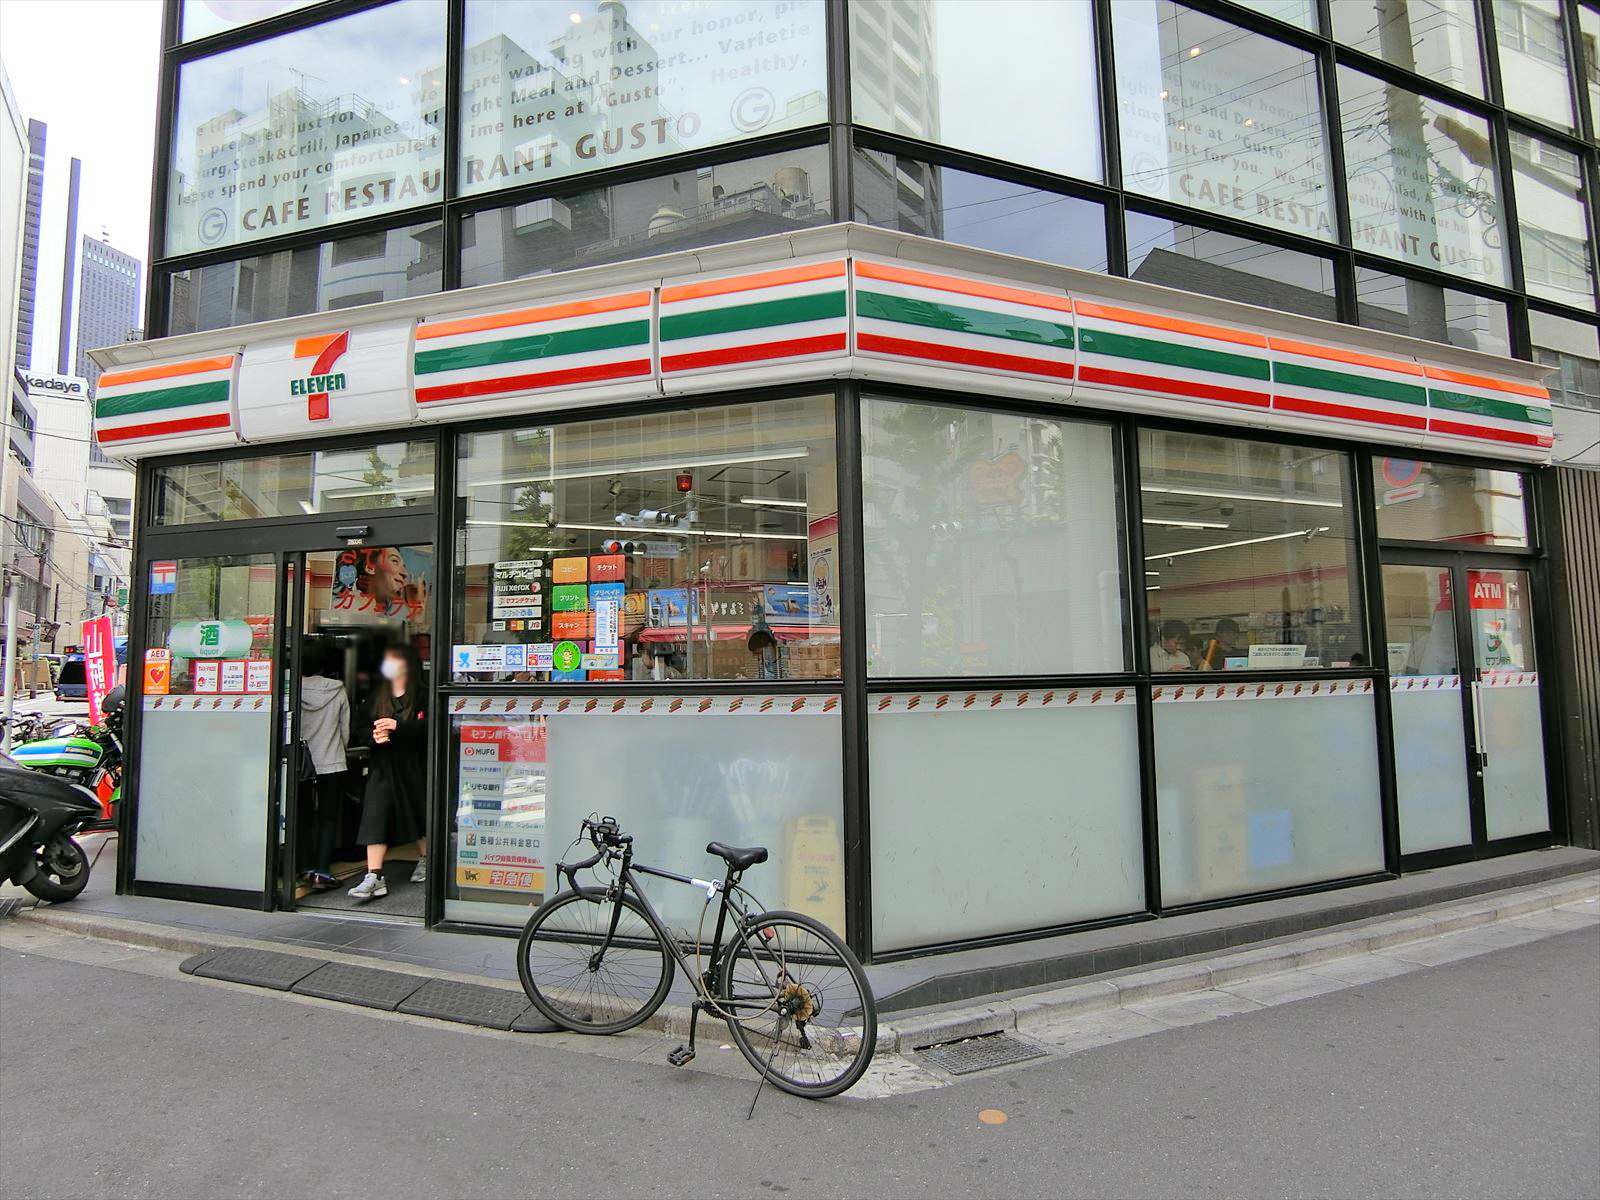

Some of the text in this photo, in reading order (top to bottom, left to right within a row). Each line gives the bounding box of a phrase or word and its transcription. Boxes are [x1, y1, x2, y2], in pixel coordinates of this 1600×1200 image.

[511, 80, 556, 105] Meal
[564, 70, 600, 93] and
[512, 108, 556, 129] here
[564, 99, 585, 117] at
[466, 111, 702, 185] RANT GUSTO
[220, 173, 267, 198] spend
[272, 166, 310, 189] your
[1178, 173, 1247, 211] CAFÉ
[242, 167, 442, 231] CAFÉ RESTAU
[1399, 206, 1427, 224] with
[293, 330, 349, 421] 7
[1473, 582, 1502, 599] ATM
[199, 624, 221, 646] 酒
[150, 648, 166, 658] AED
[475, 748, 496, 756] MUFG
[471, 783, 501, 792] りそな銀行
[490, 870, 534, 887] 宅急便
